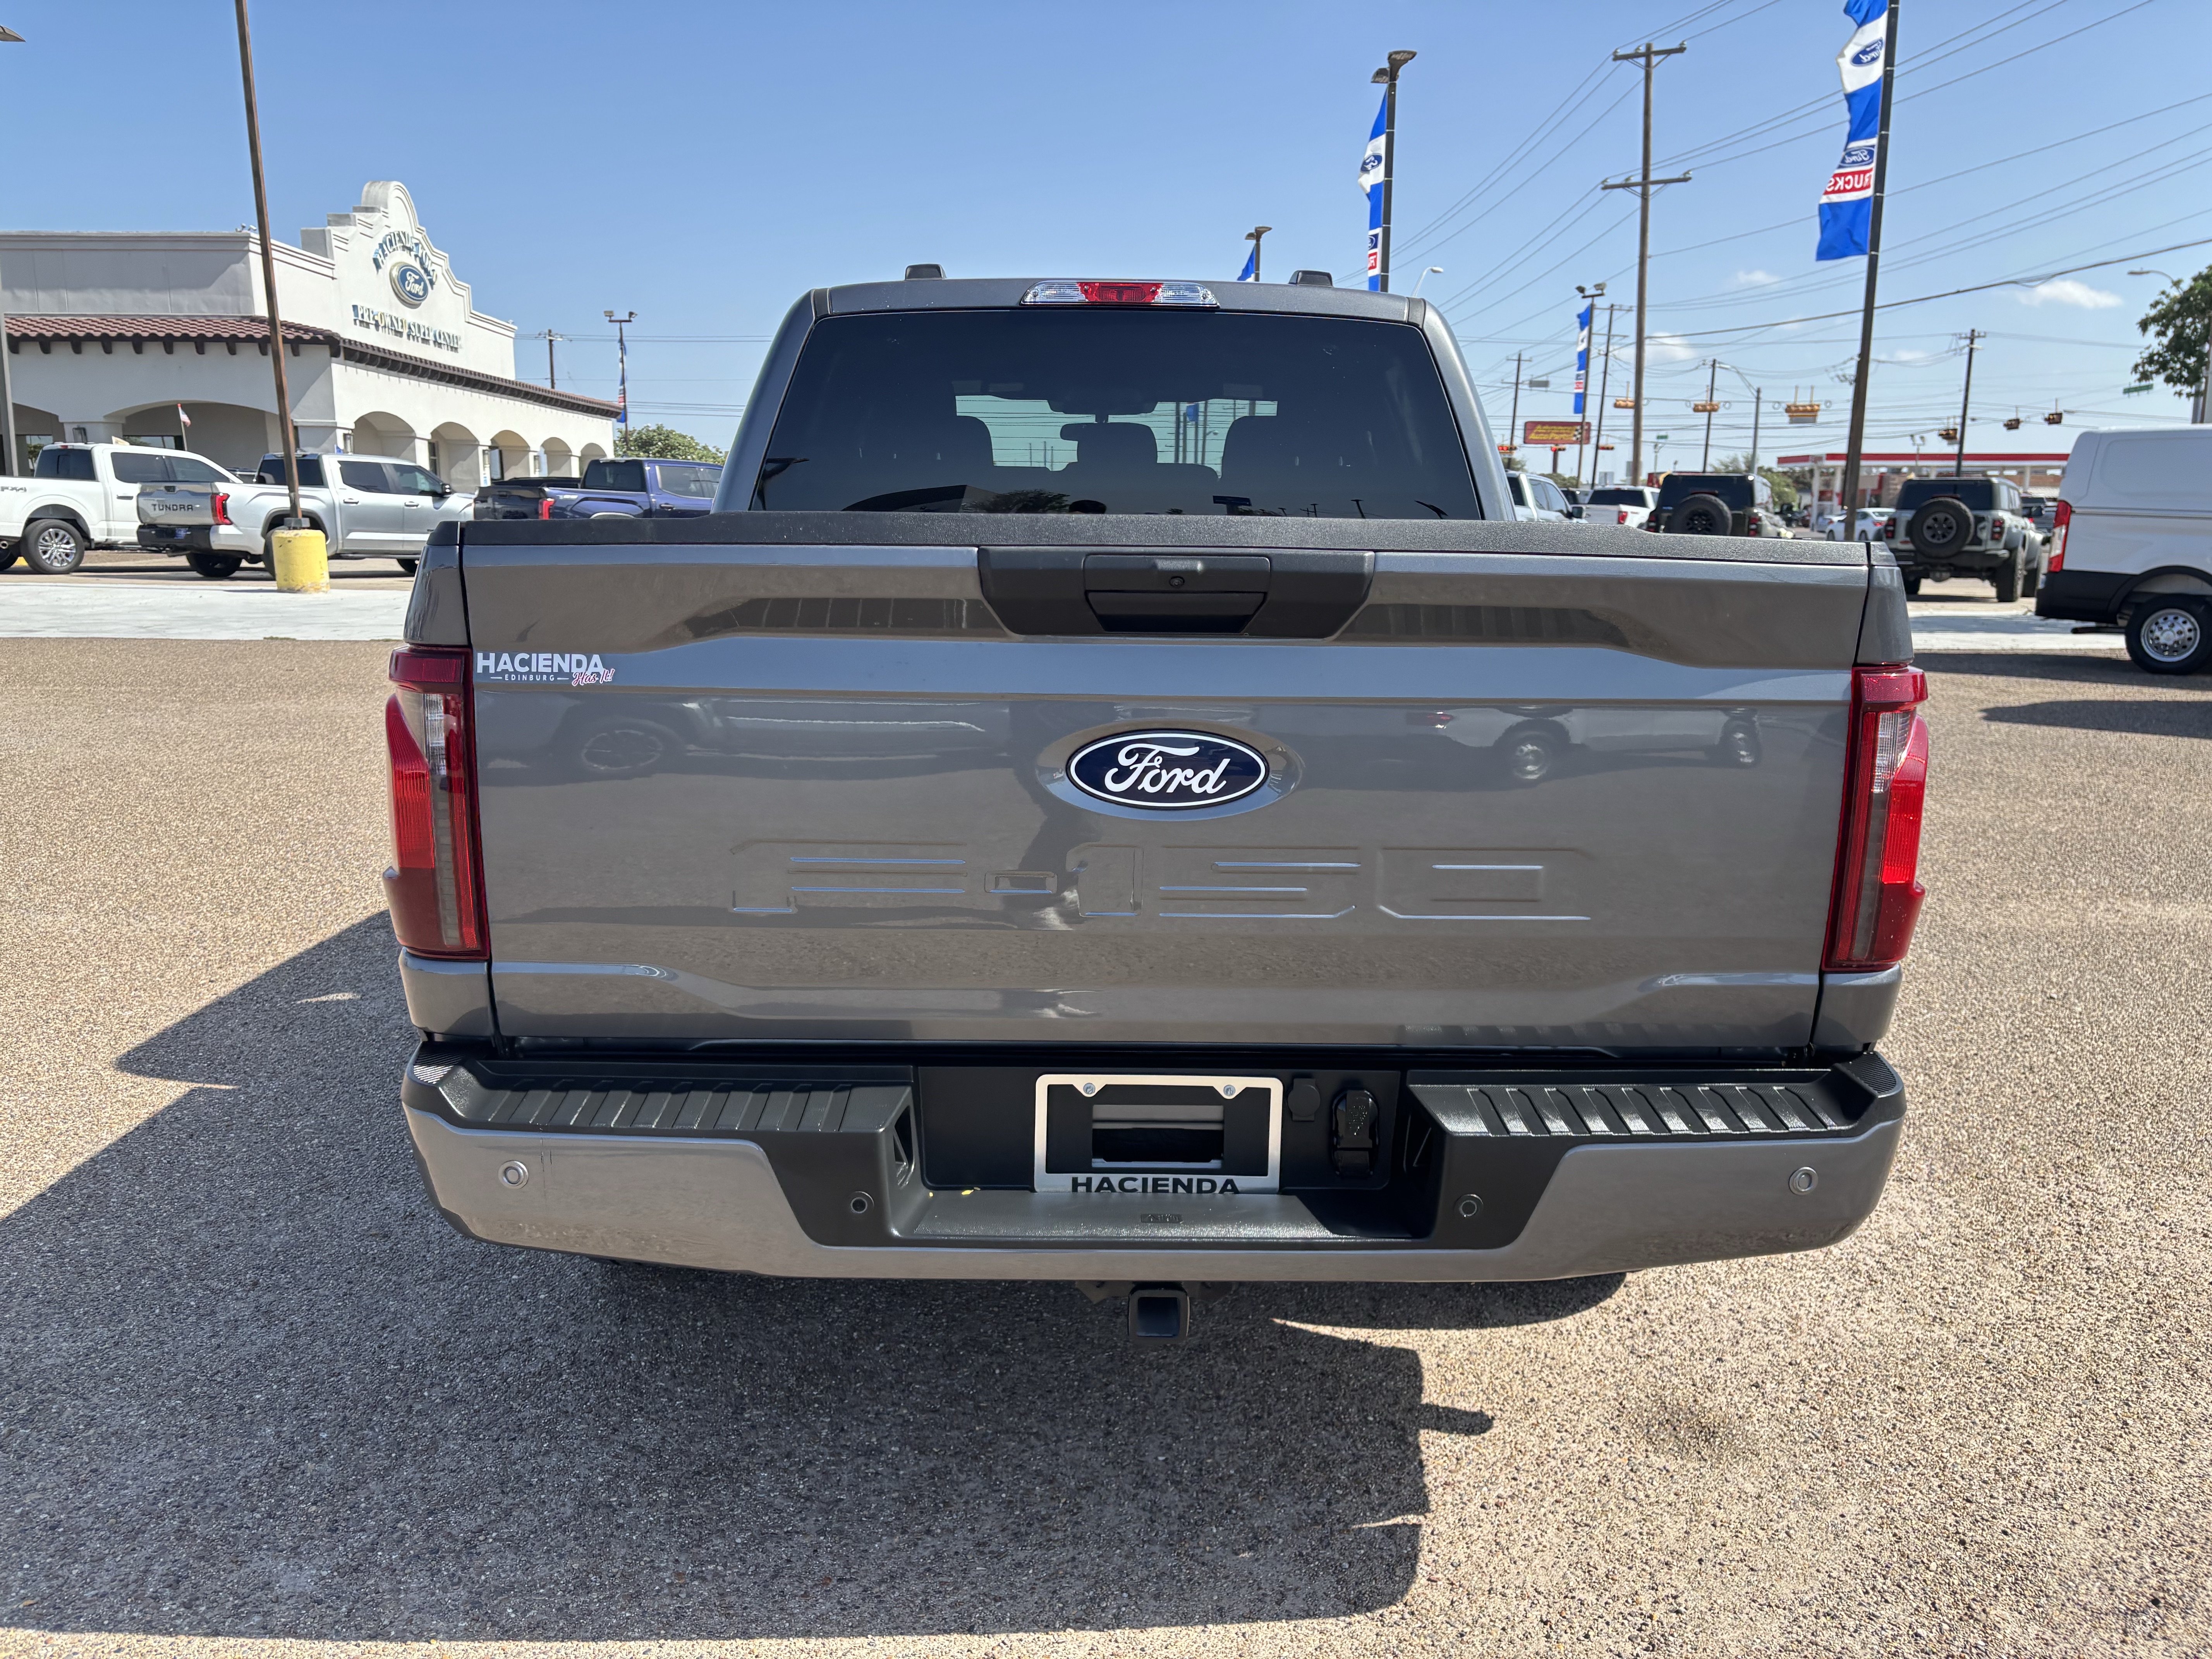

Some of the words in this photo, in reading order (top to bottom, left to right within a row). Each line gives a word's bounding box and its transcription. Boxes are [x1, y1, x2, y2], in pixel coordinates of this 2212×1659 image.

[405, 271, 424, 296] Ford
[477, 653, 604, 673] HACIENDA
[572, 672, 599, 687] Has
[599, 668, 615, 684] It!
[1104, 743, 1231, 794] Ford
[1071, 1177, 1240, 1194] HACIENDA
